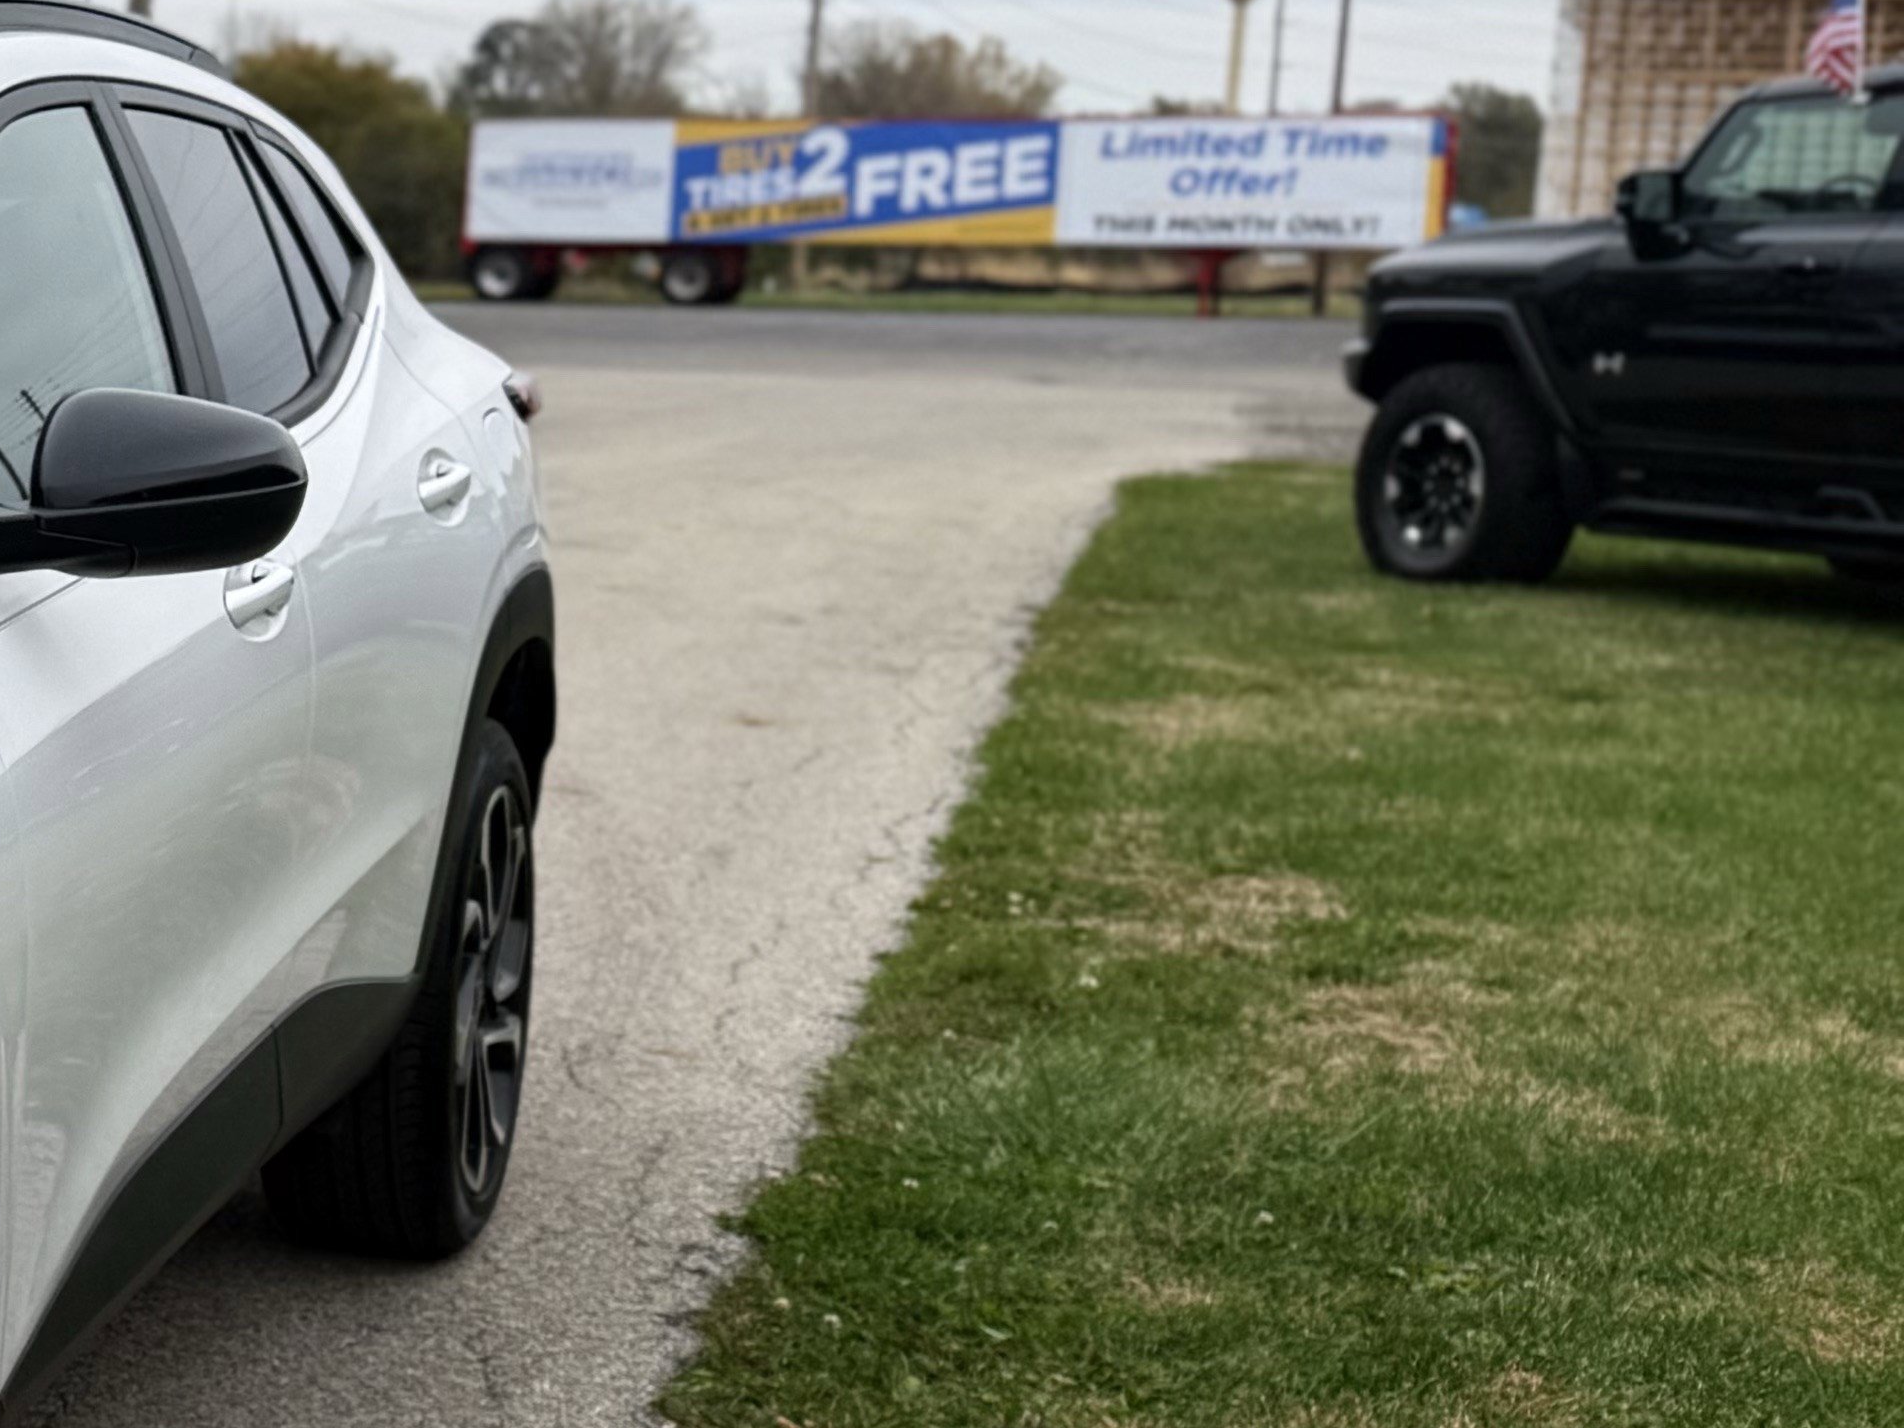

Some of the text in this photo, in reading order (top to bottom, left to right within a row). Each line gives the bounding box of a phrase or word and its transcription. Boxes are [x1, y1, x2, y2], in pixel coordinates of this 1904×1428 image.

[1099, 128, 1388, 160] Limited Time
[800, 126, 850, 198] 2
[853, 134, 1053, 218] FREE
[1168, 167, 1298, 199] Offer!
[1093, 215, 1380, 235] THIS MONTH ONLY!
